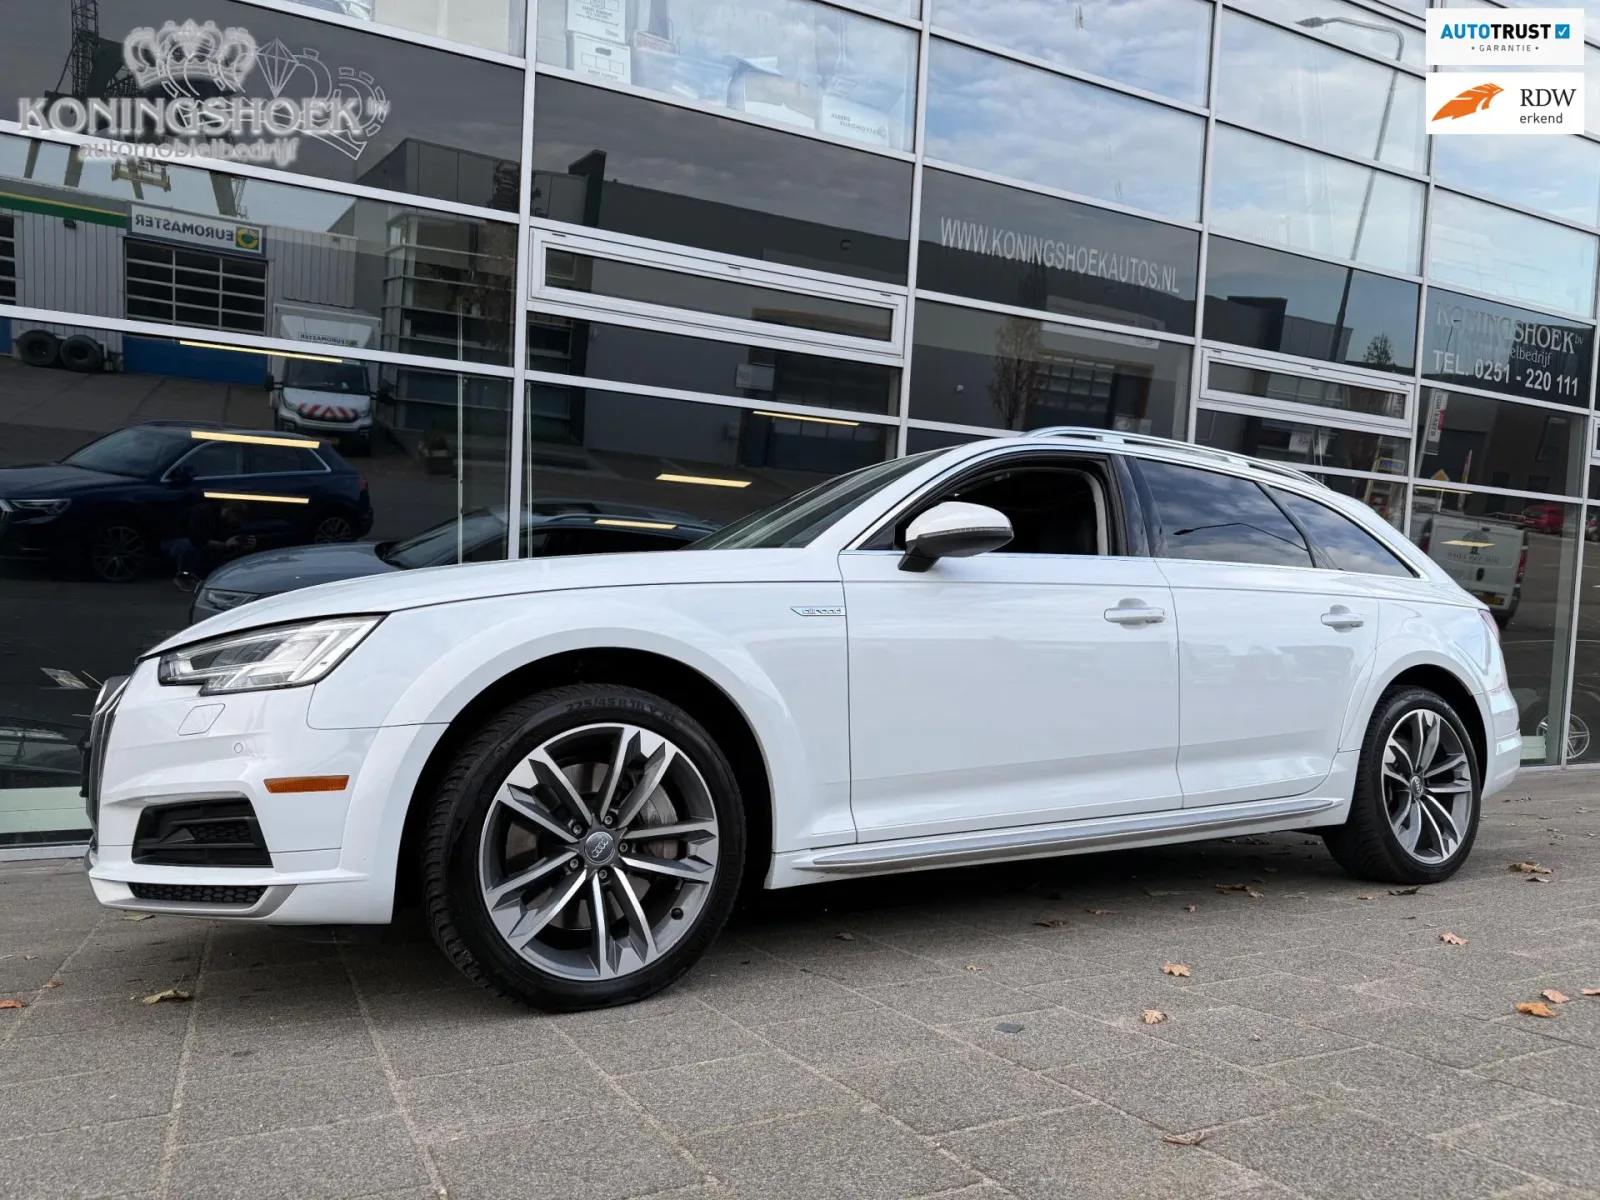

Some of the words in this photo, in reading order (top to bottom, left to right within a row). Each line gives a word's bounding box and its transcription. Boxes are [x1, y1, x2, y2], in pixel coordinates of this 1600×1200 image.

[940, 216, 1180, 293] WWW.KONINGSHOEKAUTOS.NL
[1436, 302, 1575, 354] KONINGSHOEK
[1433, 350, 1469, 376] TEL.
[1474, 358, 1510, 383] 0251
[1525, 368, 1551, 391] 220
[1556, 374, 1578, 396] 111
